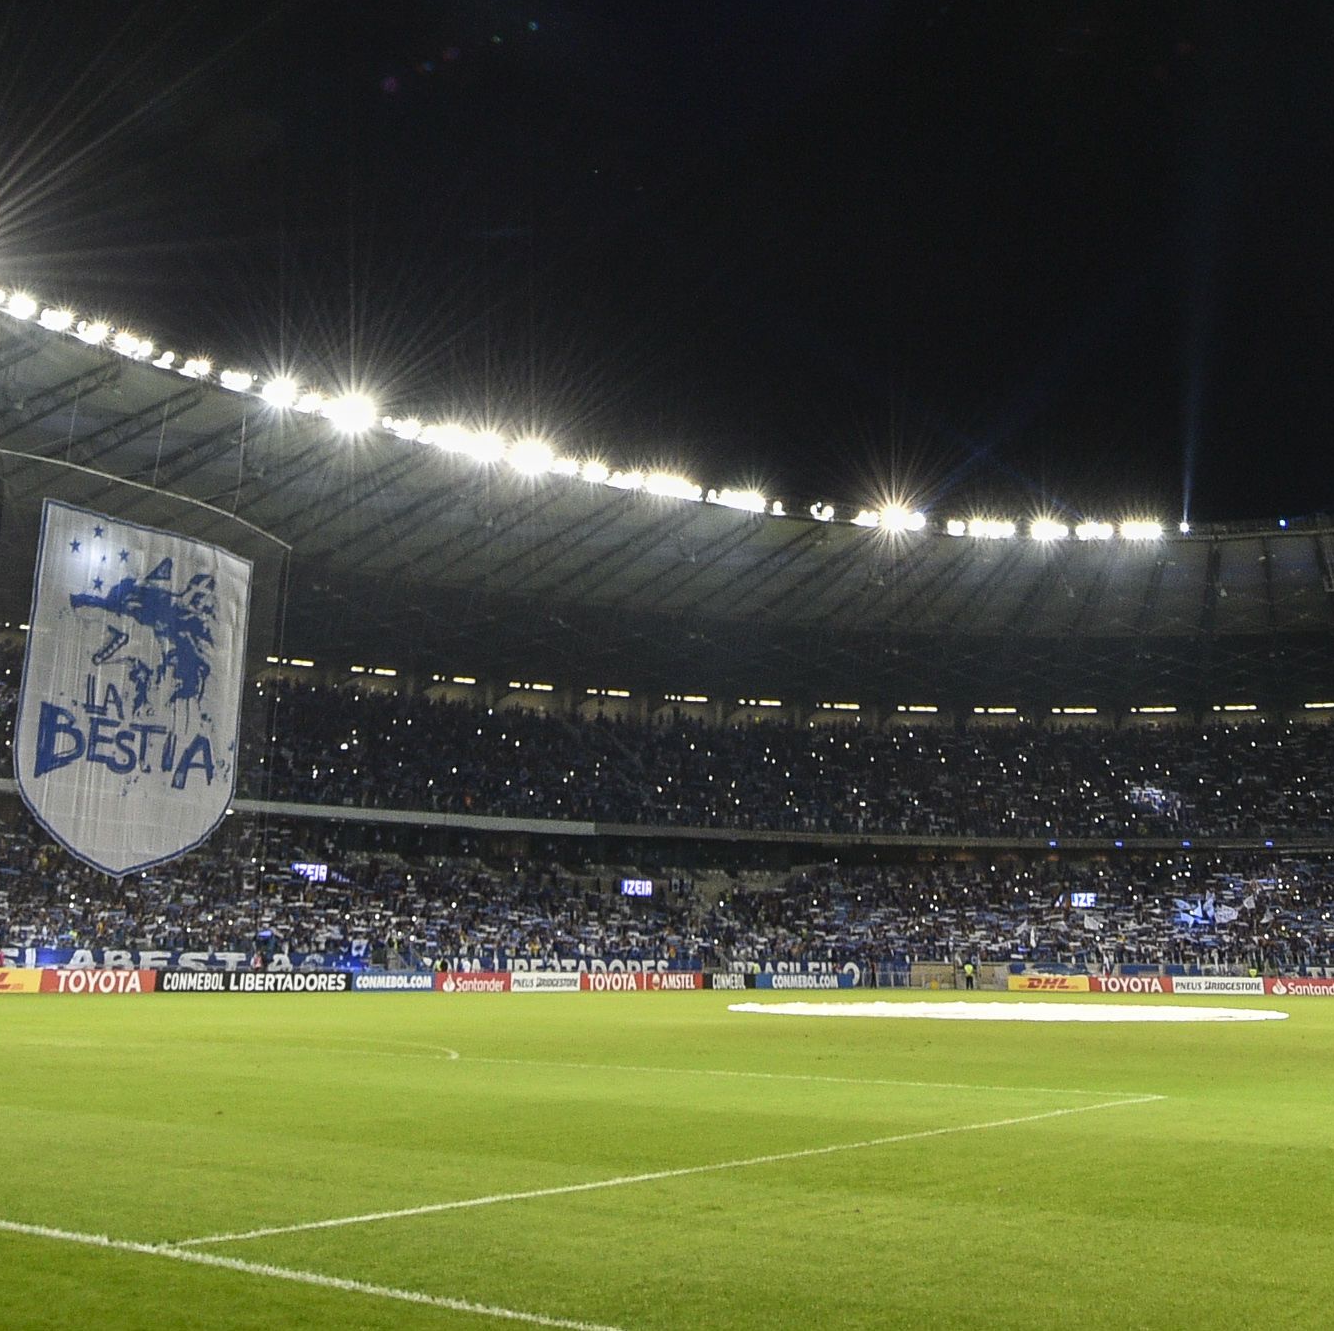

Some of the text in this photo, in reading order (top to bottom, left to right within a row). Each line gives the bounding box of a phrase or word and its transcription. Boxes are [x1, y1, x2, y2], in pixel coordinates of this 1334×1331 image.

[85, 673, 124, 719] LA
[33, 701, 215, 789] BESTIA
[56, 970, 141, 992] TOYOTA
[162, 972, 347, 991] CONMEBOL LIBERTADORES
[355, 974, 432, 989] CONMEBOL.COM
[455, 976, 505, 991] Santander
[587, 974, 637, 990] TOYOTA
[660, 974, 695, 989] AMSTEL
[712, 974, 746, 989] CONMEBOL
[772, 974, 838, 989] CONMEBOL.COM
[1027, 977, 1070, 990] DHL
[1098, 977, 1163, 993] TOYOTA
[1175, 980, 1262, 991] PNEUS BRIDGESTONE
